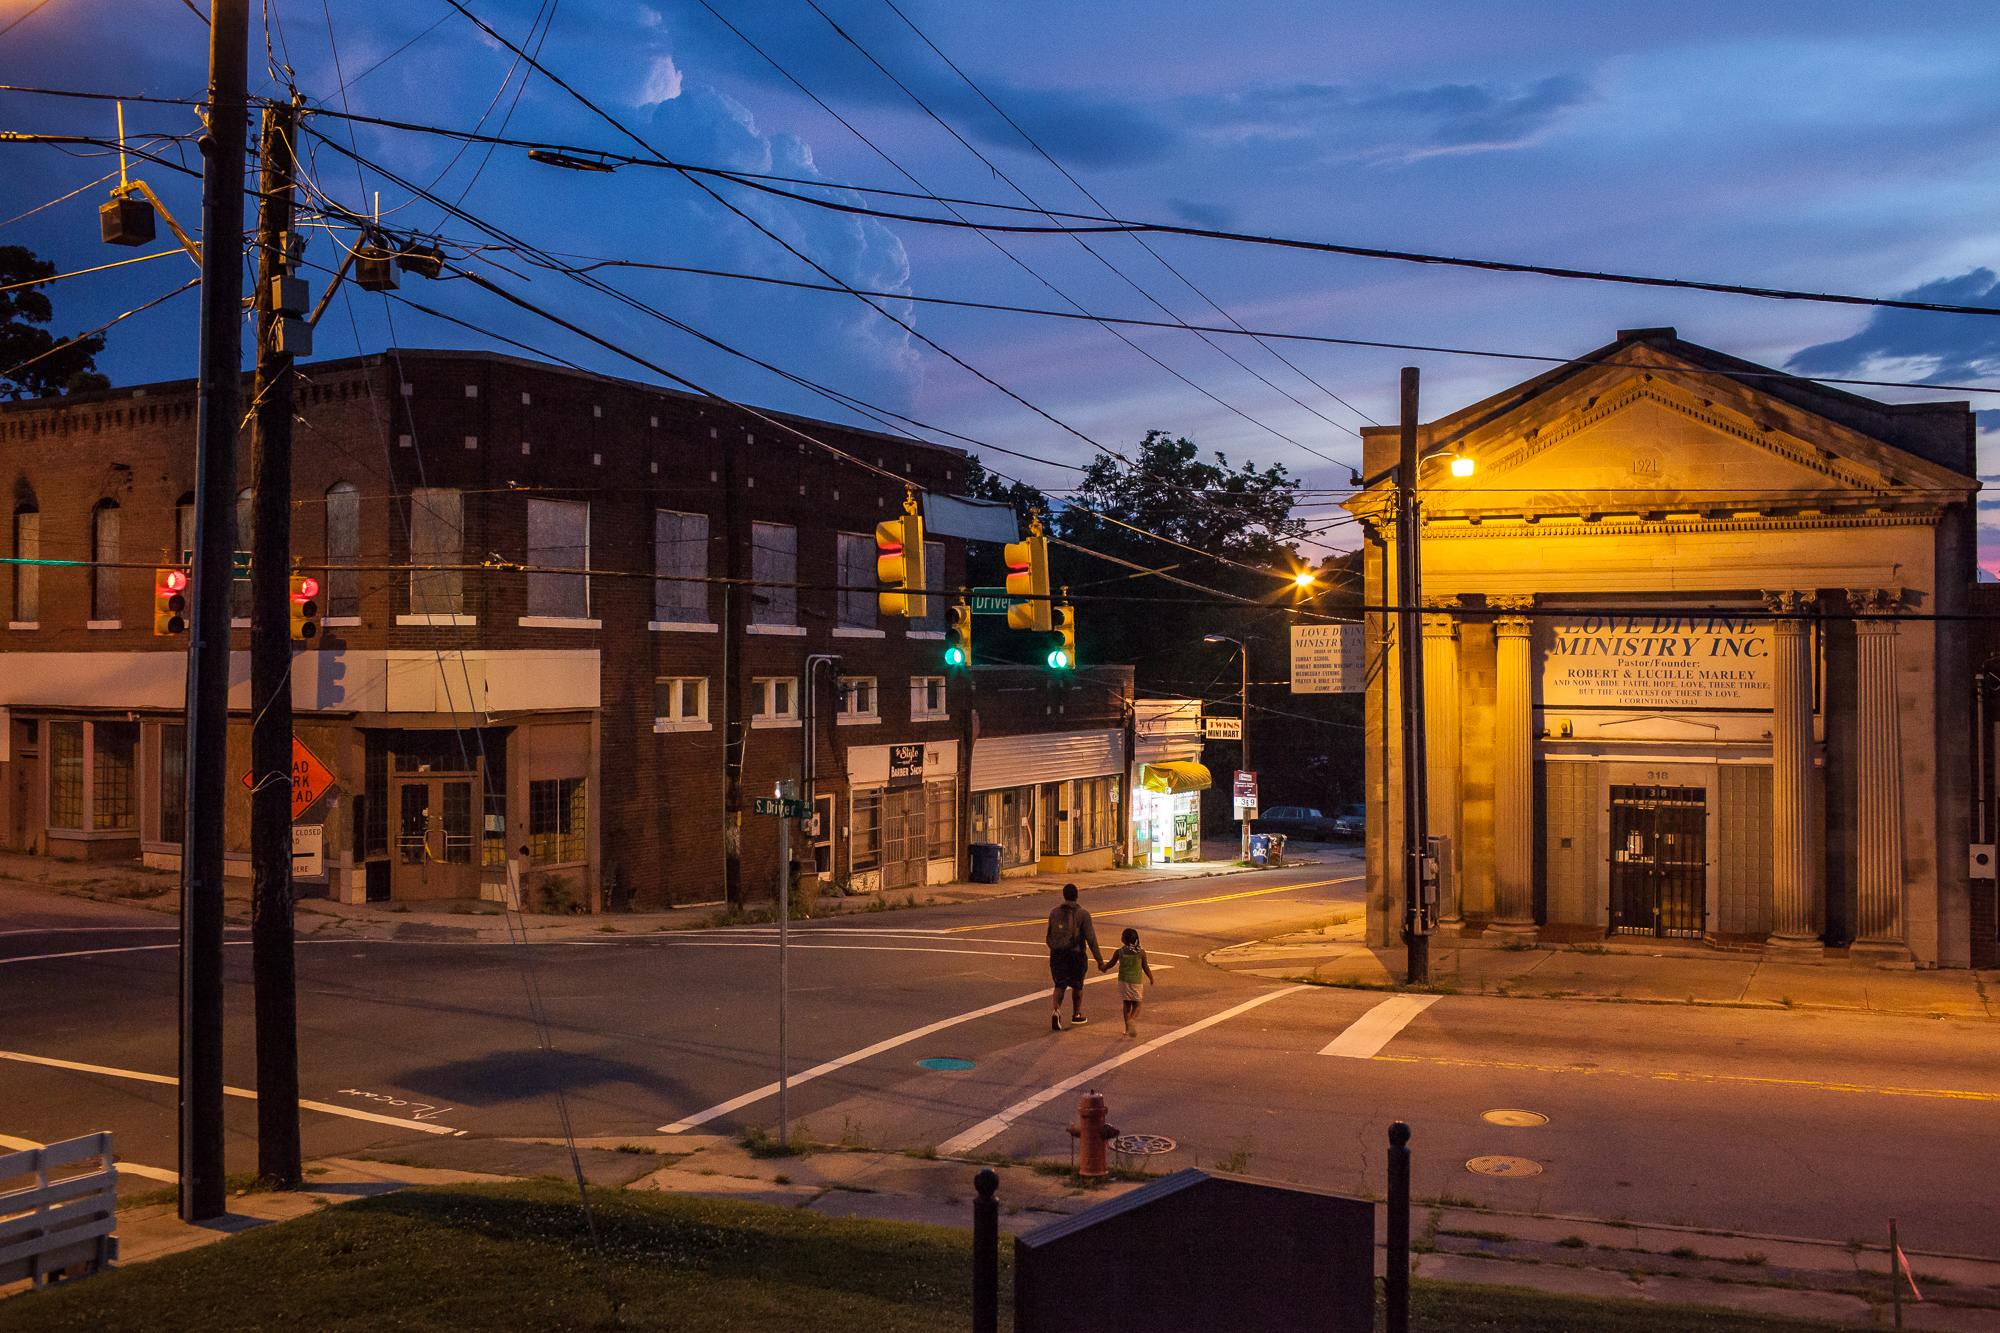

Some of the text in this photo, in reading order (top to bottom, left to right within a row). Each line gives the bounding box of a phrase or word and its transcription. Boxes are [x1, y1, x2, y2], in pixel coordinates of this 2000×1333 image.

[1563, 617, 1757, 635] LOVE DIVINE
[1301, 628, 1329, 637] LOVE
[1352, 638, 1365, 647] IN
[1553, 637, 1769, 658] MINISTRY INC.
[1618, 659, 1700, 668] Pastor/Founder:
[1568, 669, 1756, 680] ROBERT & LUCILLE MARLEY
[1623, 680, 1651, 688] FAITH,
[1209, 721, 1240, 730] TWINS
[1208, 730, 1239, 738] MINI MART
[900, 746, 919, 761] Style
[1647, 770, 1669, 780] 318
[1650, 788, 1667, 797] 38
[756, 799, 764, 813] S.
[766, 800, 796, 816] Driver
[295, 828, 321, 836] CLOSED
